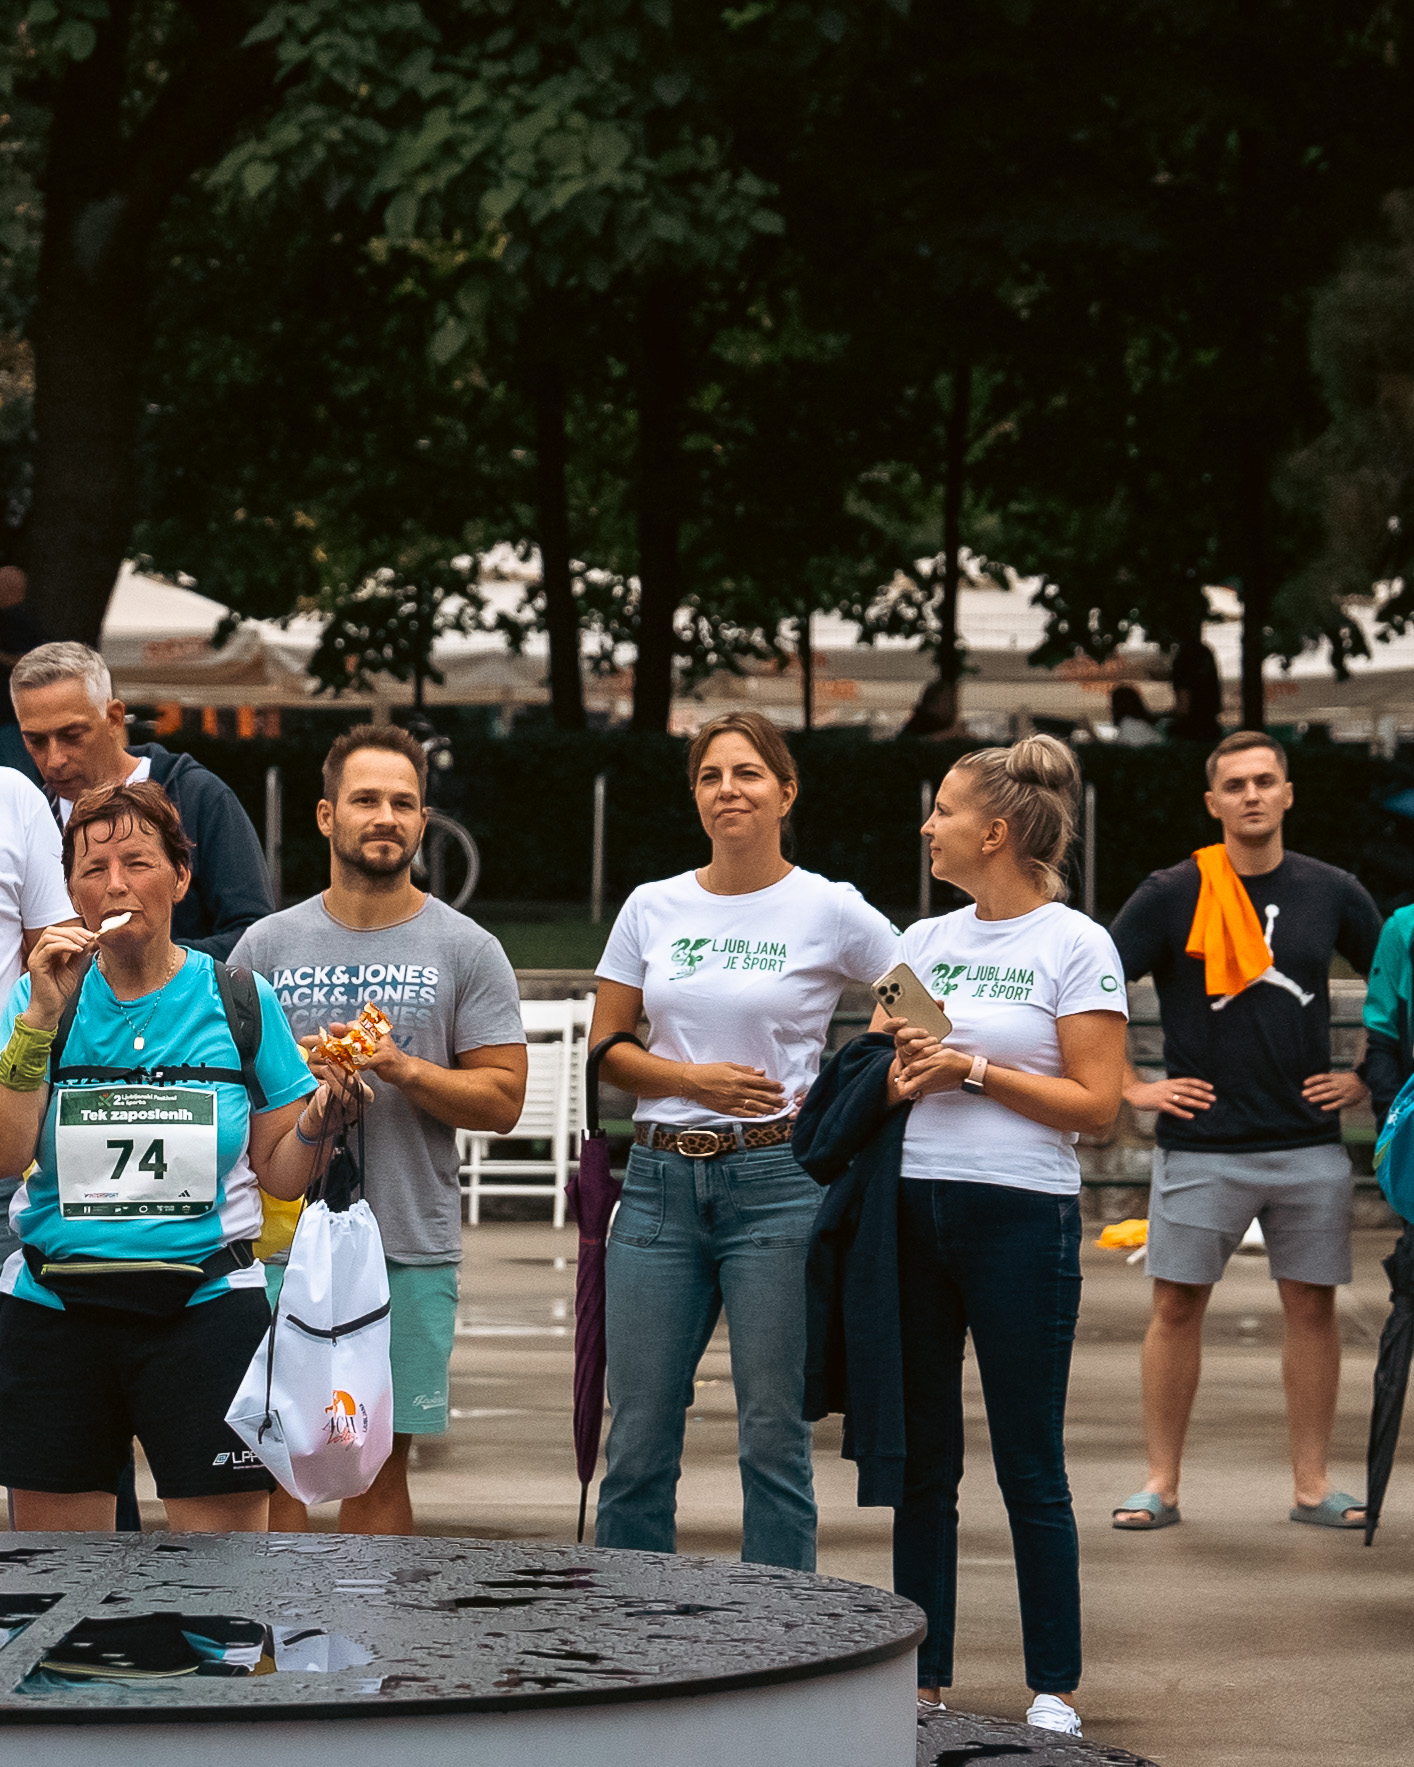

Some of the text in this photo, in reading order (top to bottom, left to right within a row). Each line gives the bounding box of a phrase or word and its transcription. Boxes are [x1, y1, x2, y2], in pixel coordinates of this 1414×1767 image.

[711, 938, 787, 958] LJUBLJANA
[722, 954, 786, 973] JE ŠPORT
[965, 965, 1035, 986] LJUBLJANA
[279, 985, 436, 1008] ACK&JONES
[971, 981, 1033, 1001] JE ŠPORT
[80, 1108, 193, 1123] Tek zaposlenih
[106, 1138, 168, 1180] 74
